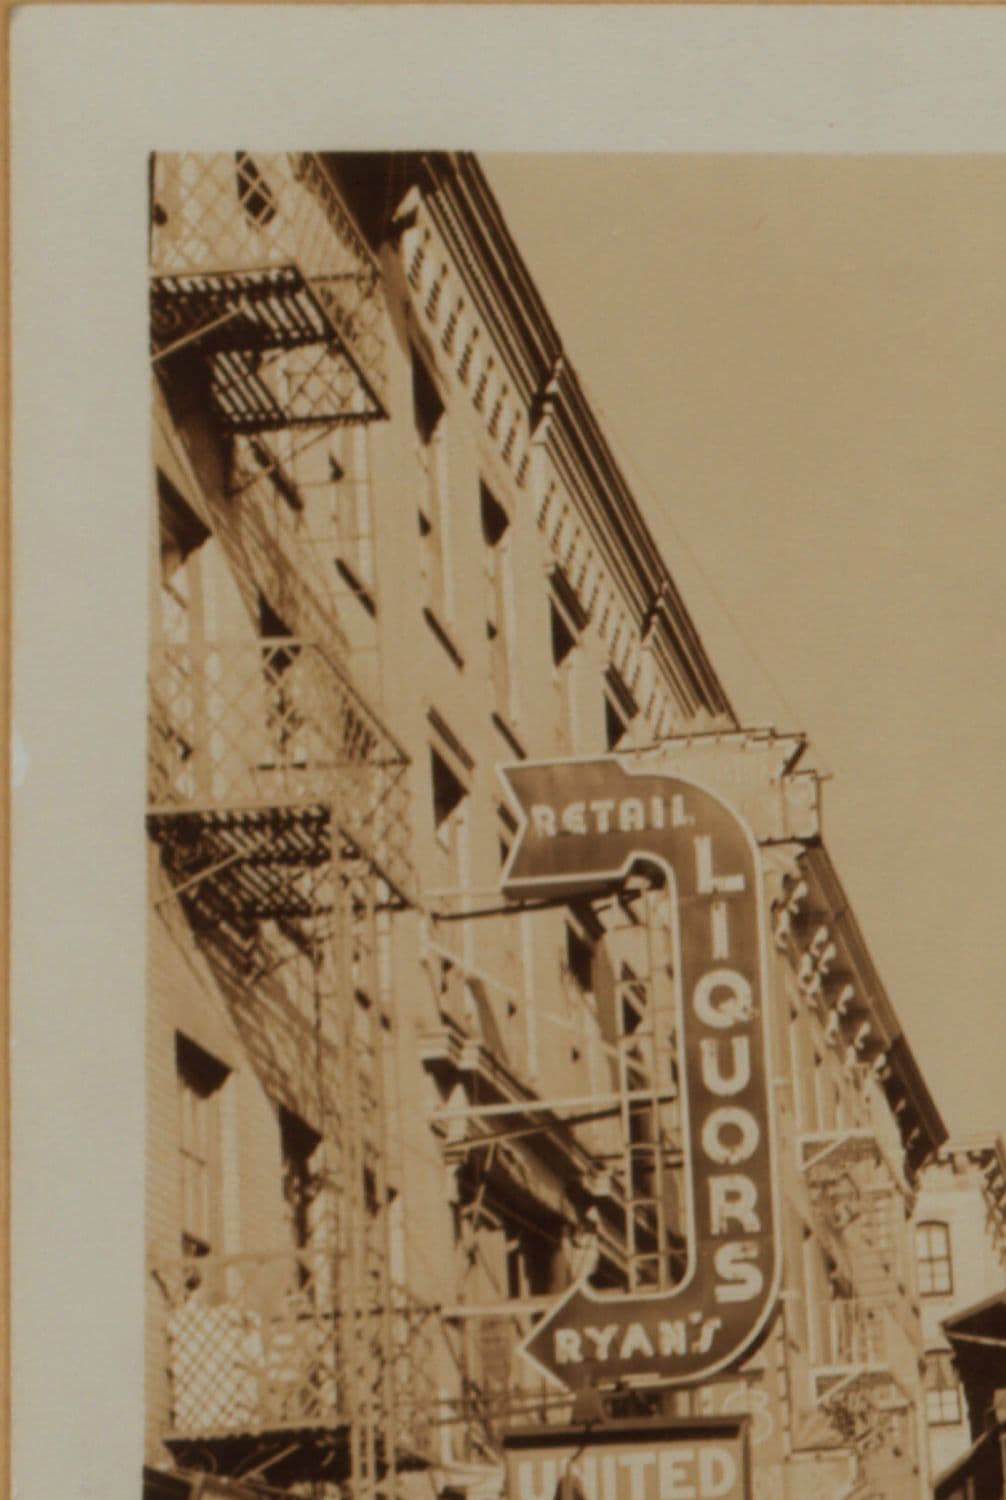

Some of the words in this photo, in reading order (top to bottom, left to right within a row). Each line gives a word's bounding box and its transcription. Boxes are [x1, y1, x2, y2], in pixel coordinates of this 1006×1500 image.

[530, 794, 695, 838] RETAIL
[693, 835, 765, 1303] LIQUORS
[553, 1312, 721, 1364] RYAN'S
